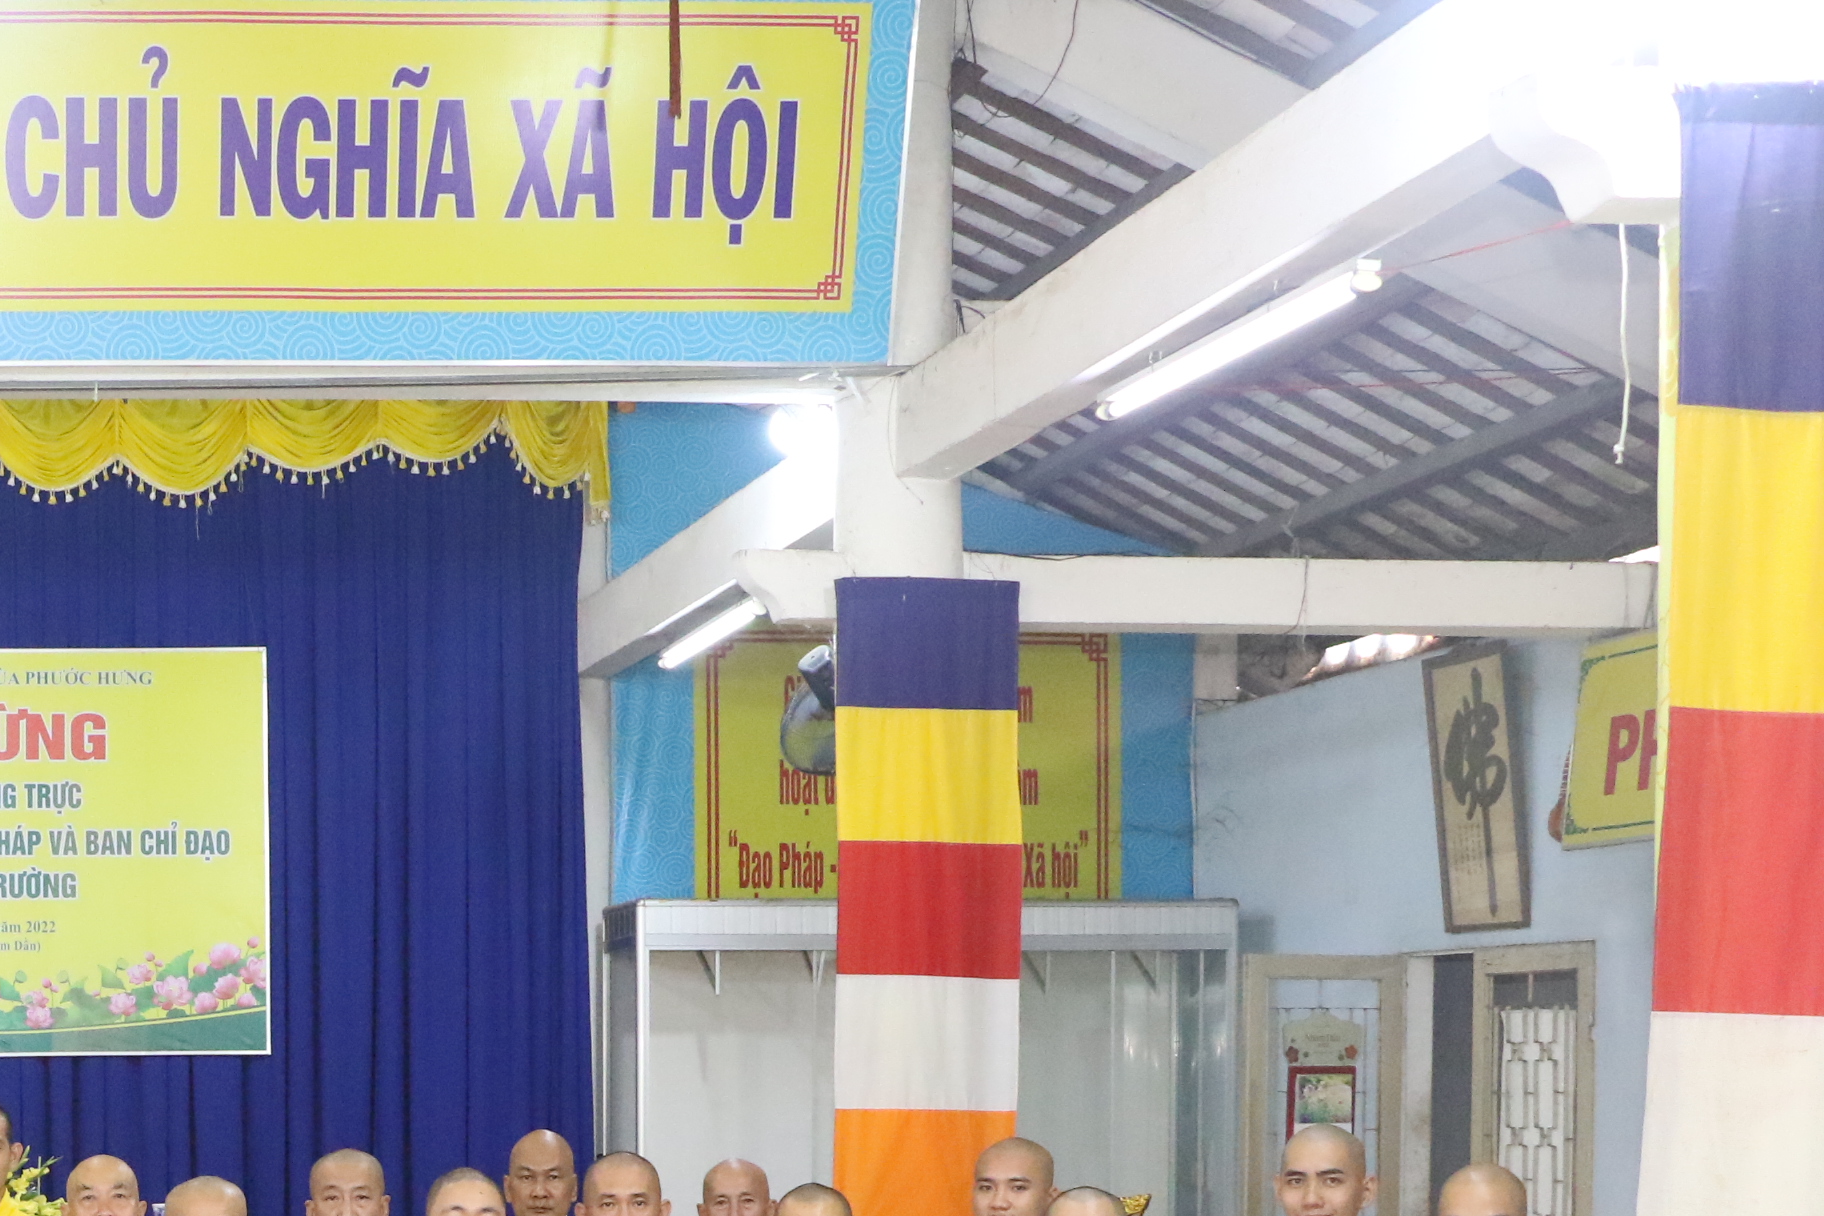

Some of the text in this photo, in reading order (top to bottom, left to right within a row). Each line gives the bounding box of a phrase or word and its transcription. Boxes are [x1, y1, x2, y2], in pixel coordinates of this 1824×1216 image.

[5, 46, 178, 221] CHỦ
[219, 65, 475, 222] NGHĨA
[504, 65, 617, 221] XÃ
[652, 65, 800, 245] HỘI
[25, 667, 91, 686] PHƯỚC
[98, 669, 153, 686] HƯNG
[24, 780, 83, 815] TRỰC
[49, 825, 78, 856] VÀ
[86, 830, 133, 856] BAN
[140, 821, 178, 855] CHỈ
[184, 829, 231, 861] ĐẠO
[779, 841, 825, 894] Pháp
[26, 920, 56, 934] 2022
